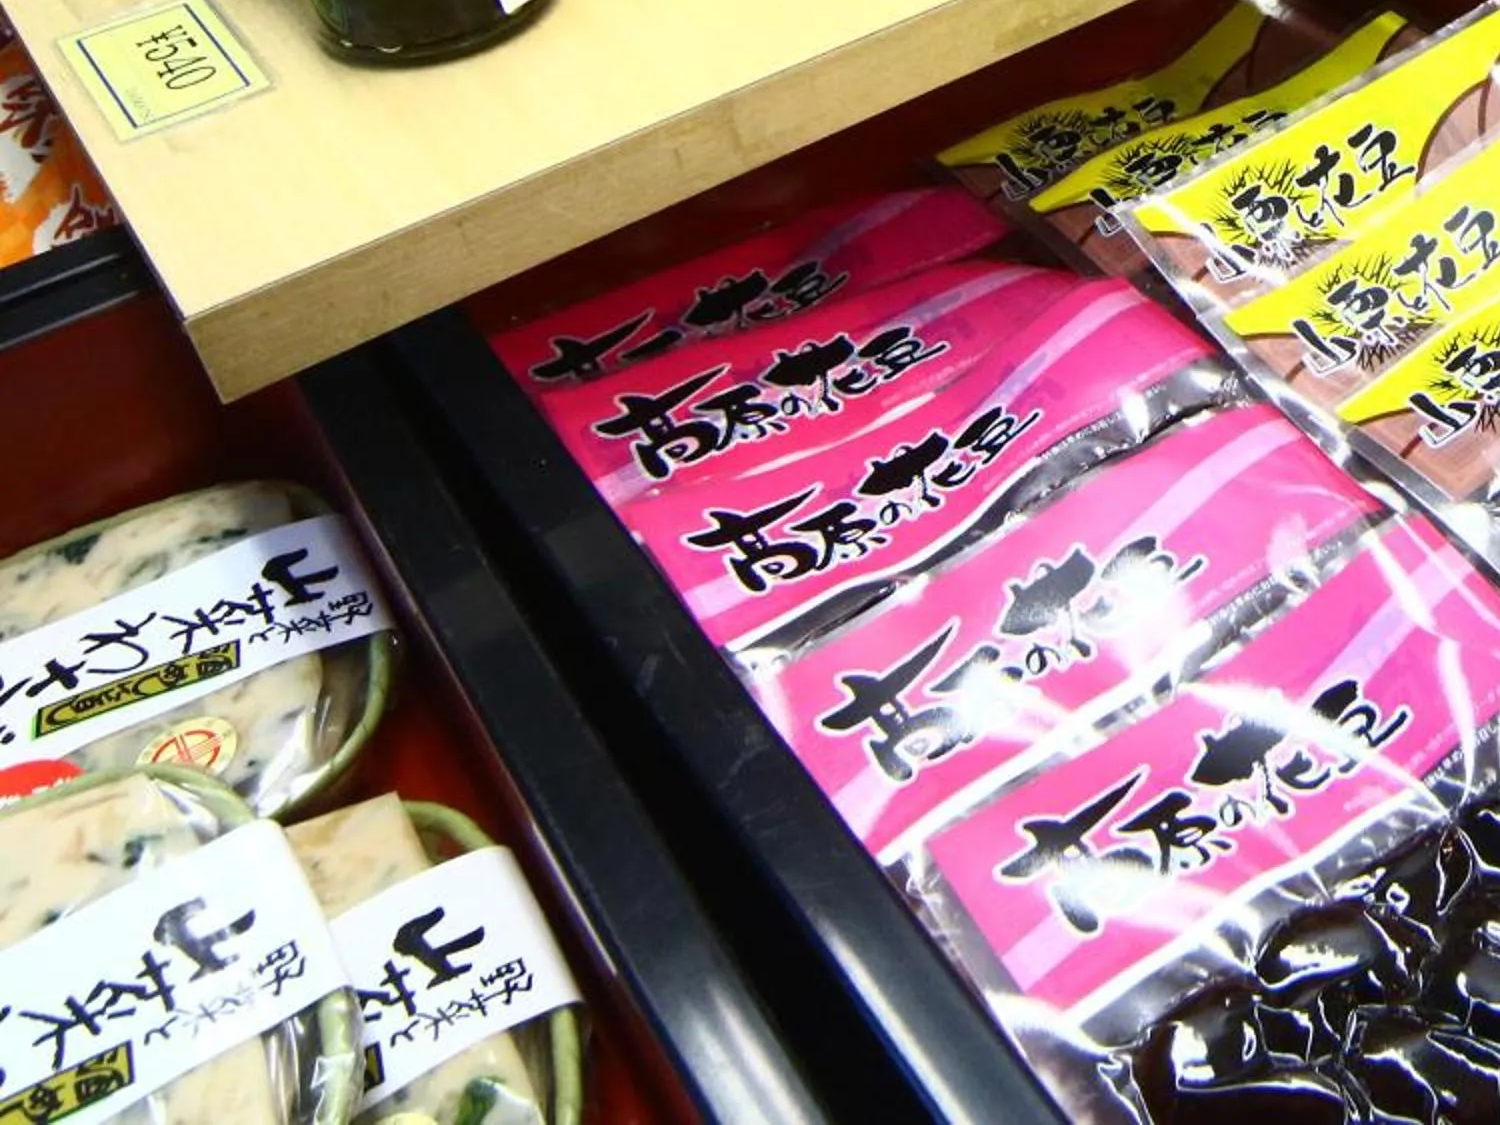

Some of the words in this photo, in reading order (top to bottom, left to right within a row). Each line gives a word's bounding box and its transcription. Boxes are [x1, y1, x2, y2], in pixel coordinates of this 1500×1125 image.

[135, 22, 217, 90] ¥540
[1206, 124, 1415, 285] 山栗と花豆
[593, 325, 949, 480] 高原の花豆
[686, 406, 1042, 594] 高原の花豆
[249, 590, 374, 644] 野菜と
[0, 898, 256, 1072] 山菜
[143, 939, 305, 1046] 野菜と
[389, 958, 533, 1046] 野菜と
